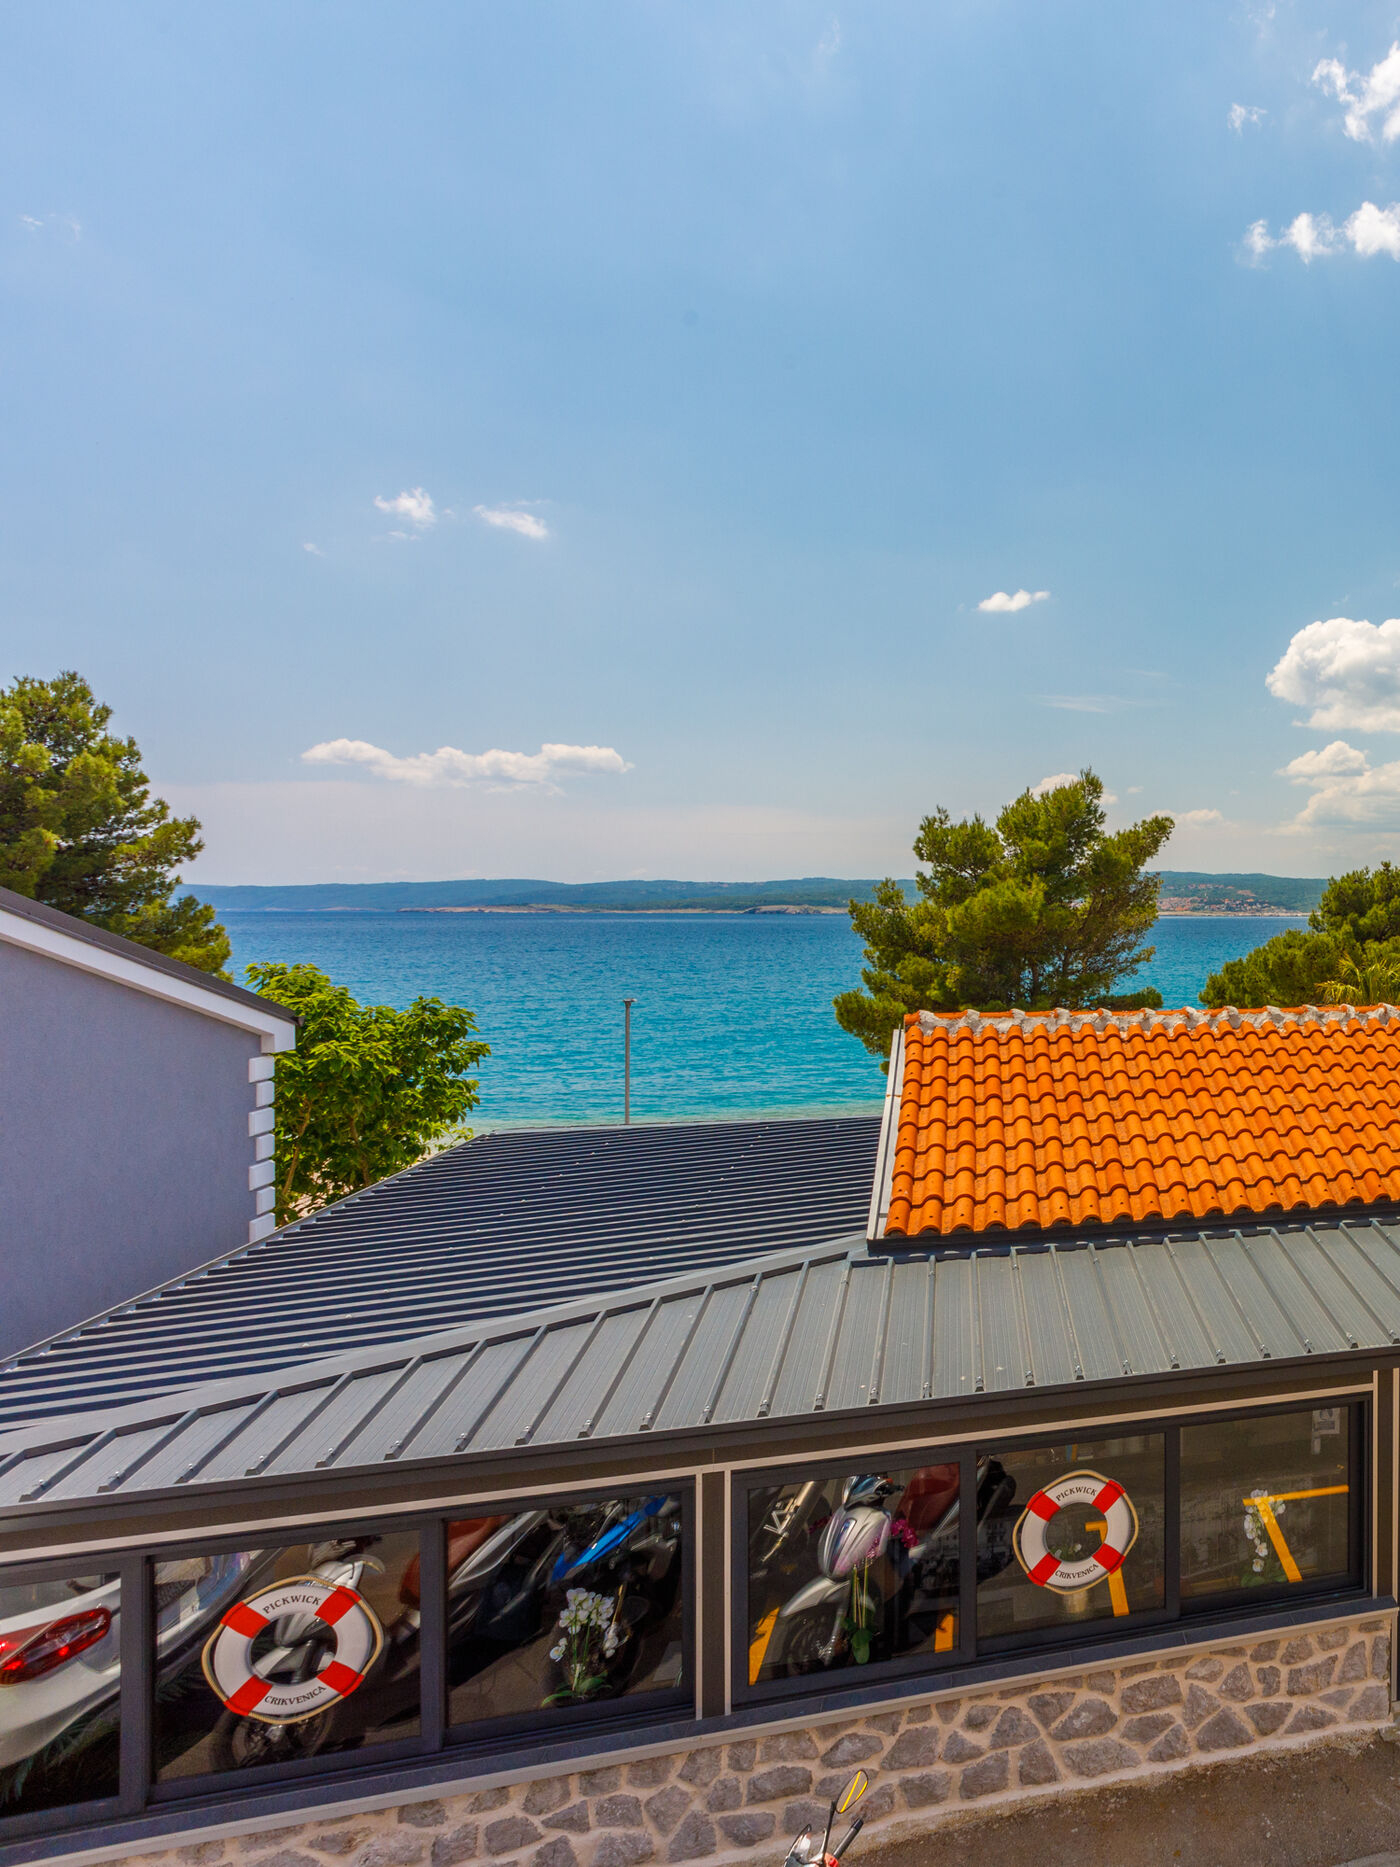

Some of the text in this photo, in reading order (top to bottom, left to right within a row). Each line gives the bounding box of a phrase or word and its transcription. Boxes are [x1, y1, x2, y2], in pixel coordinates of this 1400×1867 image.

[1056, 1486, 1097, 1502] PICKWICK
[1055, 1563, 1099, 1579] CRIKVENICA
[263, 1595, 322, 1614] PICKWICK
[264, 1685, 327, 1706] CRIKVENICA
